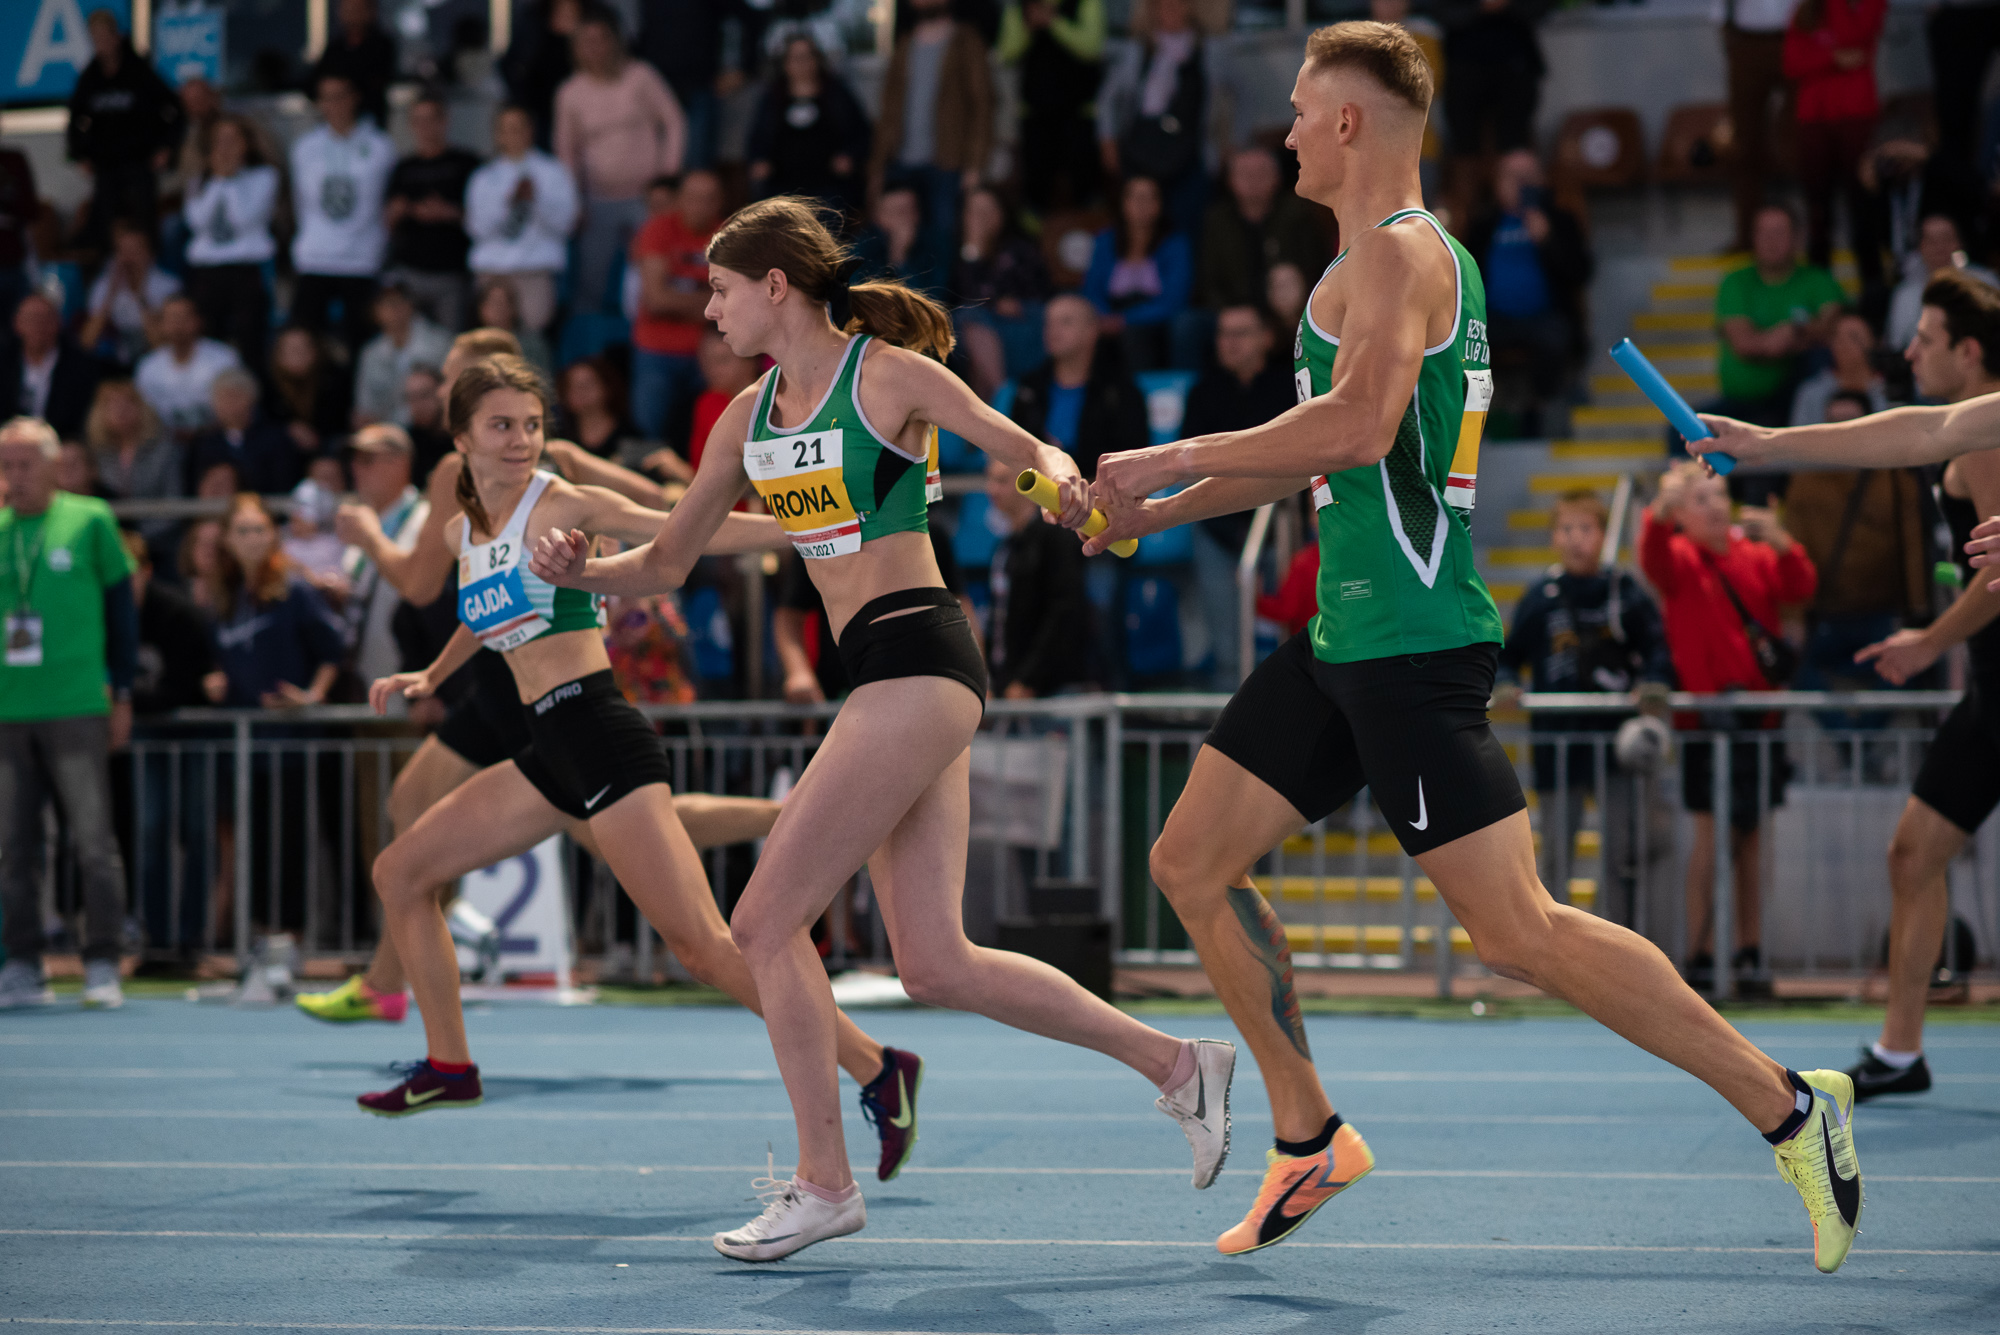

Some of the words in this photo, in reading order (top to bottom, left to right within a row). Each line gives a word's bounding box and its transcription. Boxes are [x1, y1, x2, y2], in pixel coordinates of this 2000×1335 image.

[15, 0, 96, 87] A
[792, 437, 825, 468] 21
[490, 544, 511, 569] 82
[813, 542, 836, 557] 2021
[464, 583, 514, 622] GAJDA
[555, 682, 582, 703] PRO
[483, 849, 538, 954] 2
